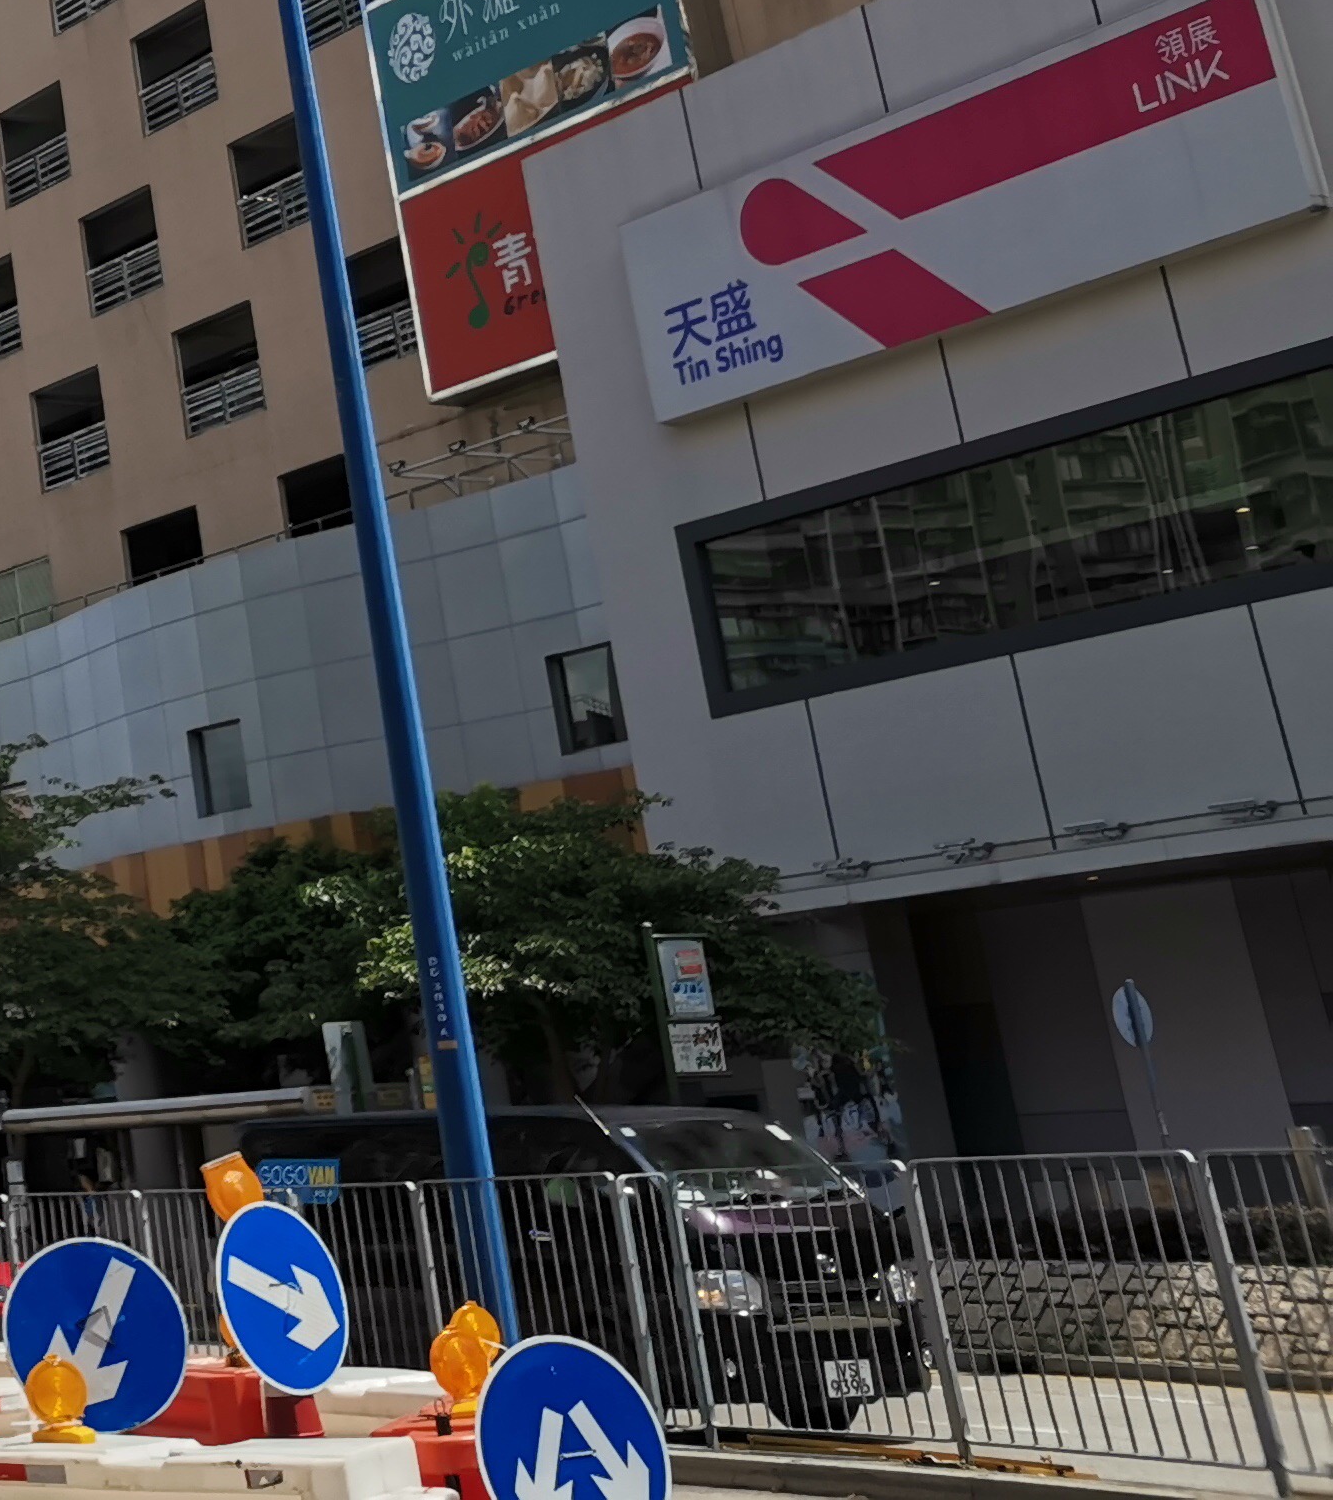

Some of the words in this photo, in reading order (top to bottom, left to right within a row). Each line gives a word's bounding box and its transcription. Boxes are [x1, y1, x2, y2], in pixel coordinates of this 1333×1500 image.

[1153, 15, 1221, 65] 領展
[1132, 50, 1231, 113] LINK
[664, 278, 757, 358] 天盛
[674, 351, 710, 386] Tin
[716, 332, 784, 374] Shing
